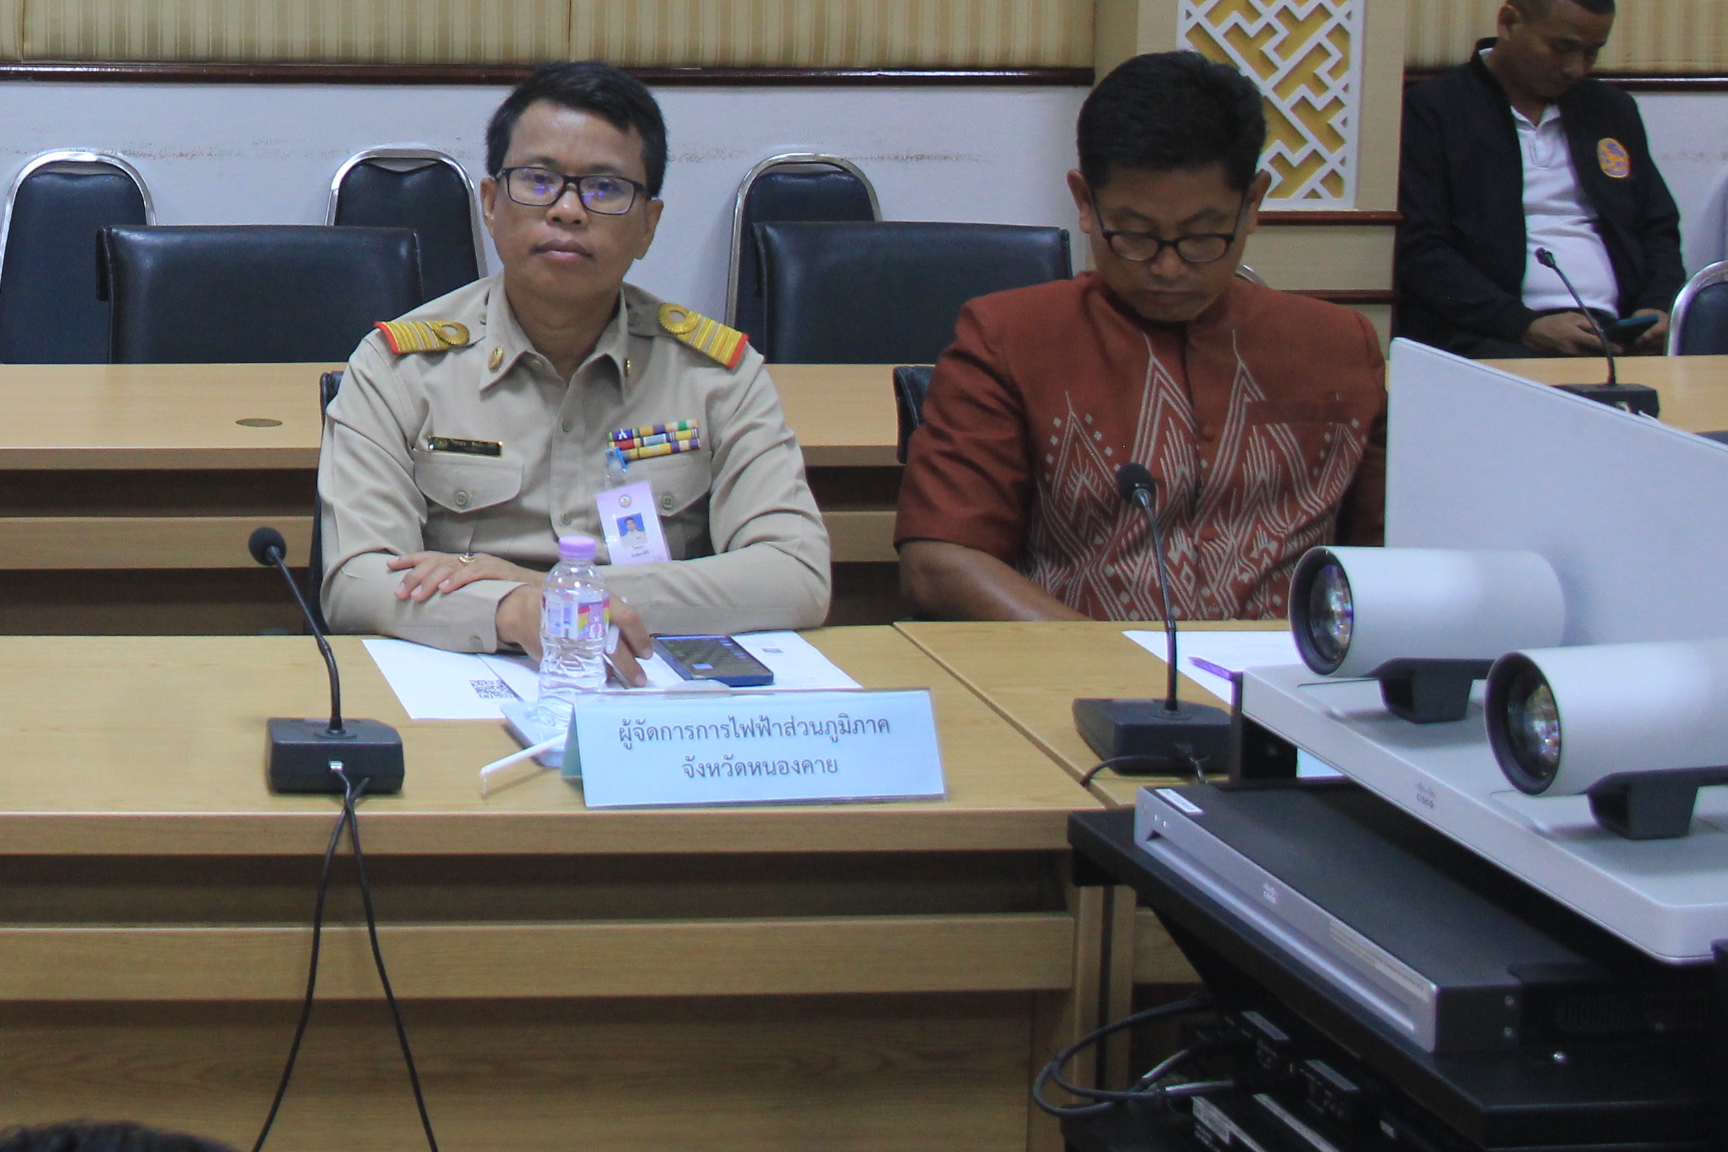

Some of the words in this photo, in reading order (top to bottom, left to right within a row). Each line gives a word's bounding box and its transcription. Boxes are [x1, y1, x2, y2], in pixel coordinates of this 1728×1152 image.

[618, 712, 891, 750] ผู้จัดการการไฟฟ้าส่วนภูมิภาค
[682, 754, 838, 779] จังหวัดหนองคาย
